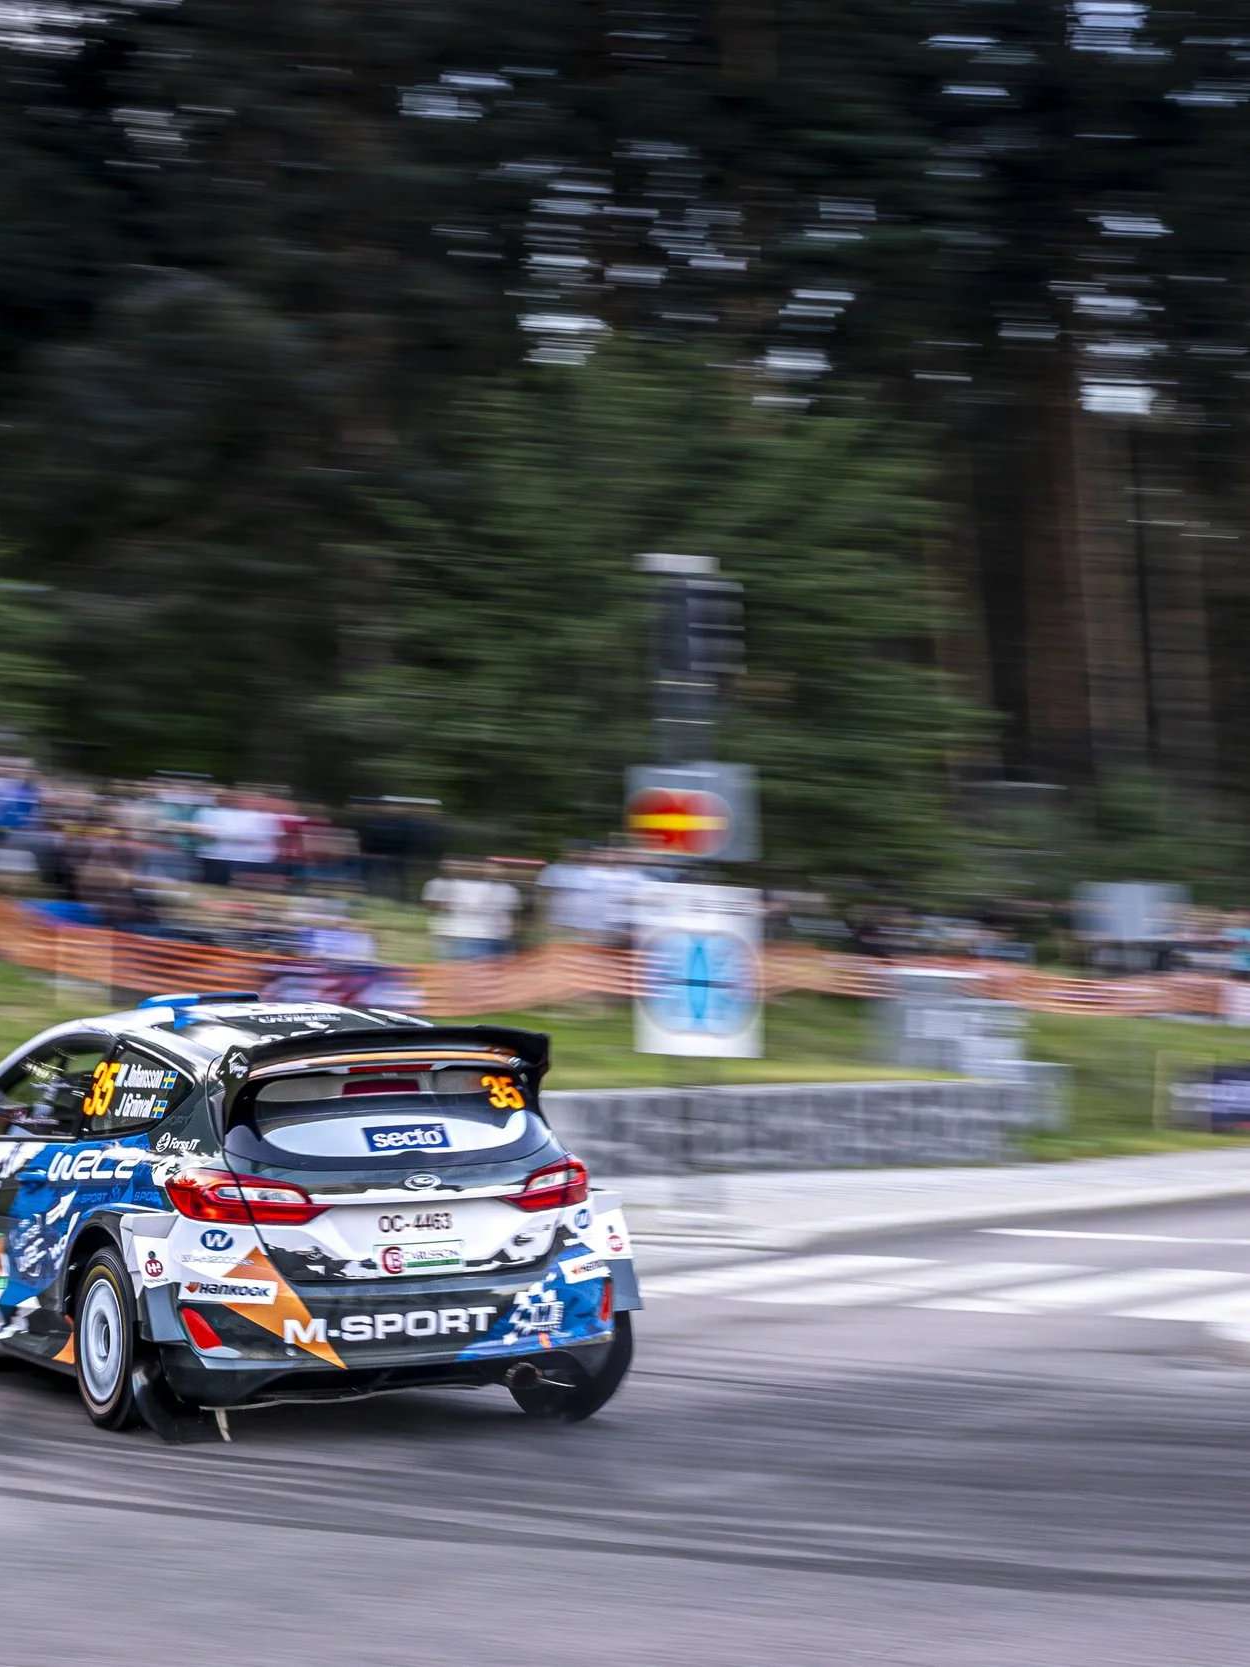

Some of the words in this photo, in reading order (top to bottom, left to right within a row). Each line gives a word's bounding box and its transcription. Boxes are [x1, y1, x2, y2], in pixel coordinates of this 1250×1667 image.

[83, 1061, 122, 1117] 35
[124, 1064, 164, 1089] Johansson
[481, 1075, 525, 1109] 35
[115, 1093, 126, 1117] J
[373, 1129, 442, 1148] secto
[378, 1213, 453, 1233] OC-4463
[284, 1306, 497, 1344] M-SPORT
